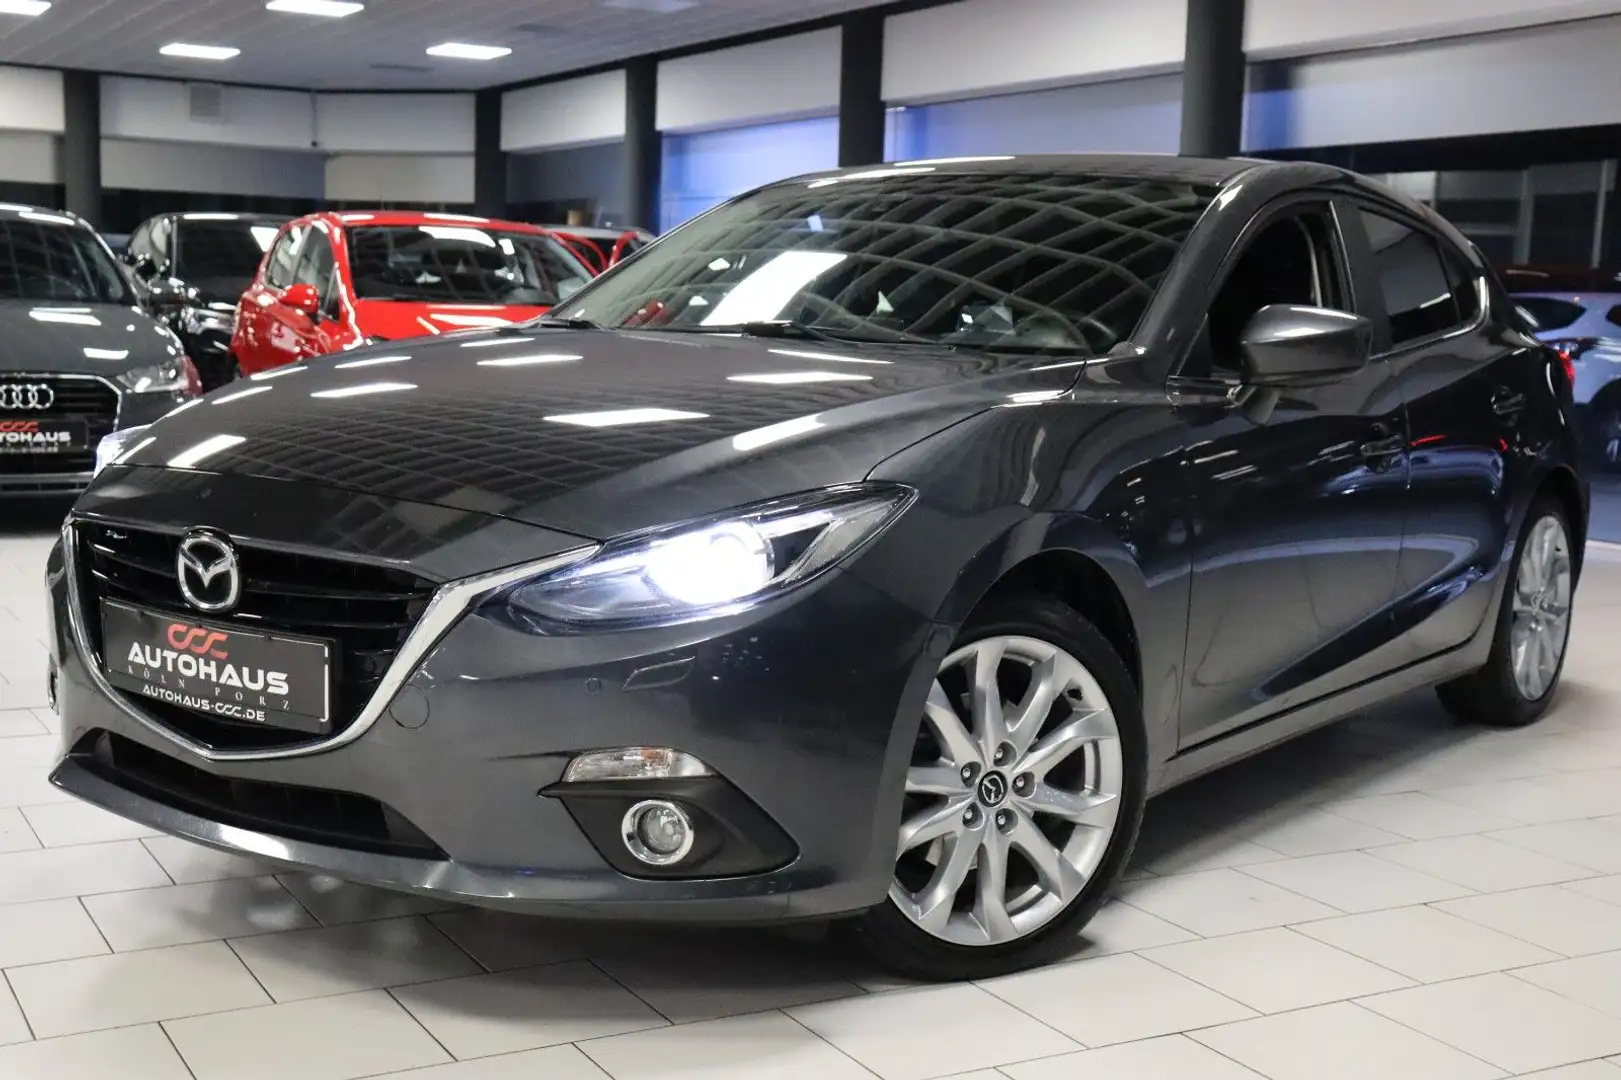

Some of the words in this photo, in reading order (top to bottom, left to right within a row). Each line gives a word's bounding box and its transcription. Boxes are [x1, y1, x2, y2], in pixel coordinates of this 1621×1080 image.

[128, 642, 289, 695] AUTOHAUS
[128, 664, 185, 689] KÖLN
[215, 687, 290, 711] PORZ
[142, 684, 266, 722] AUTOHAUS-CCC.DE
